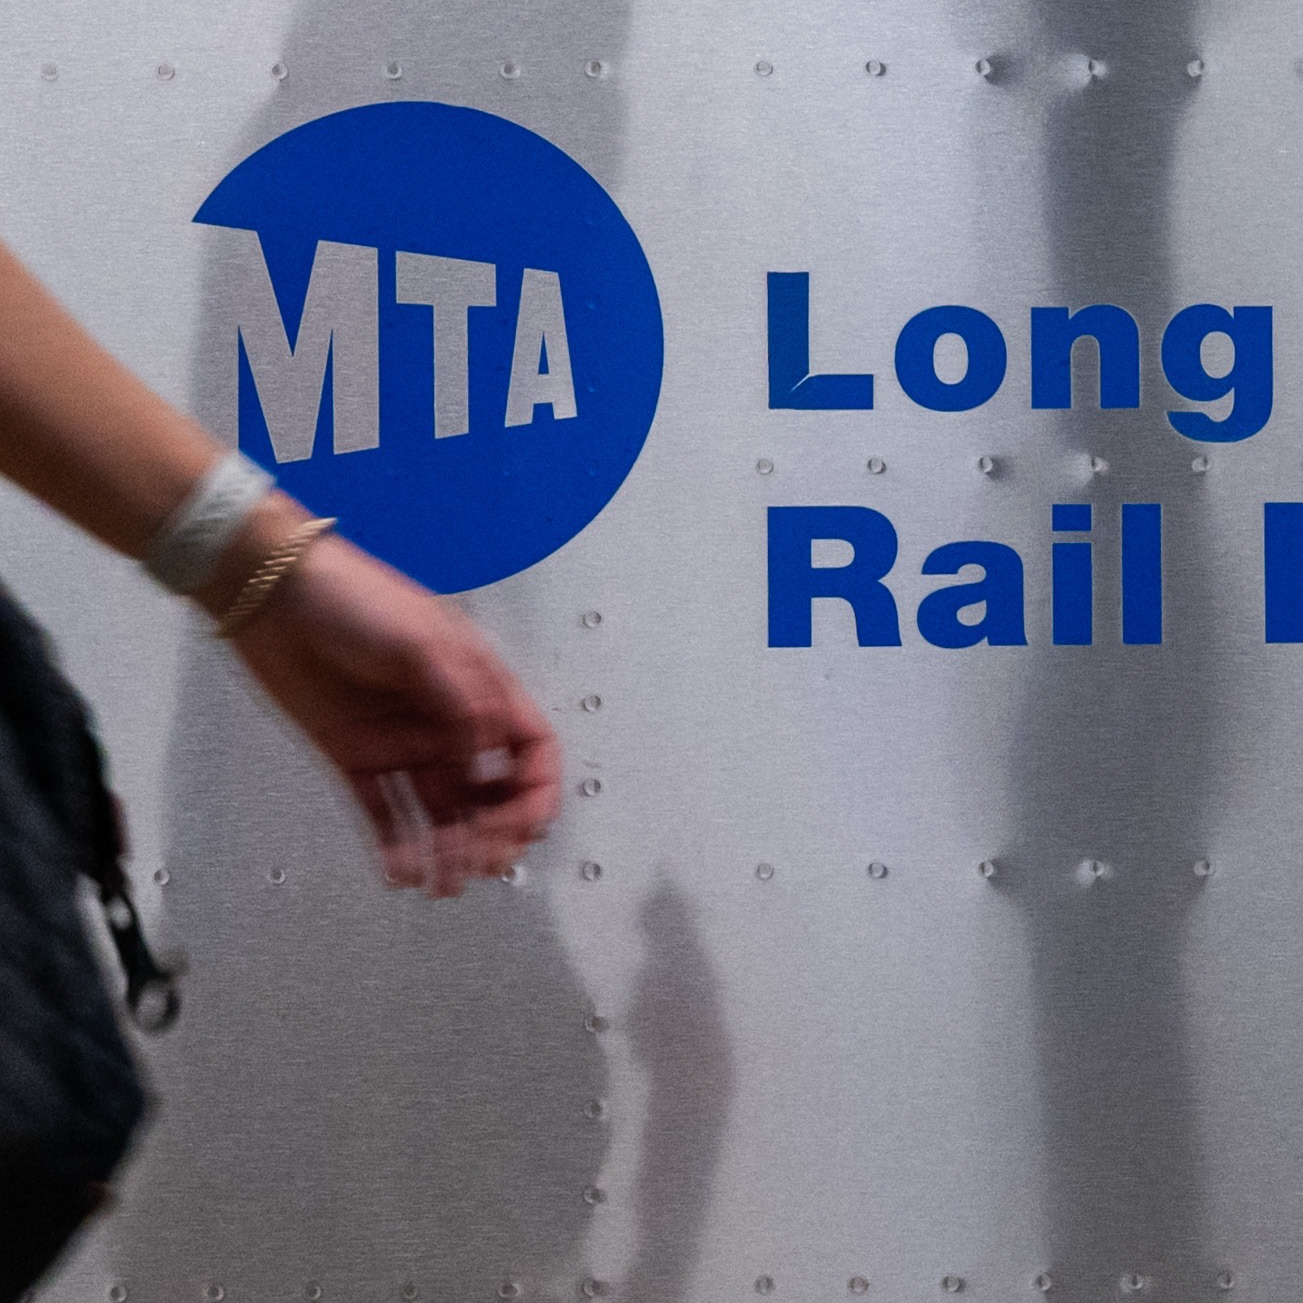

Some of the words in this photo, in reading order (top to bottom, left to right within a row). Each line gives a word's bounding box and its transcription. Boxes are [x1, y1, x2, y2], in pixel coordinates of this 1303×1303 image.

[193, 221, 579, 465] MTA
[767, 272, 1274, 443] Long
[767, 503, 1163, 649] Rail
